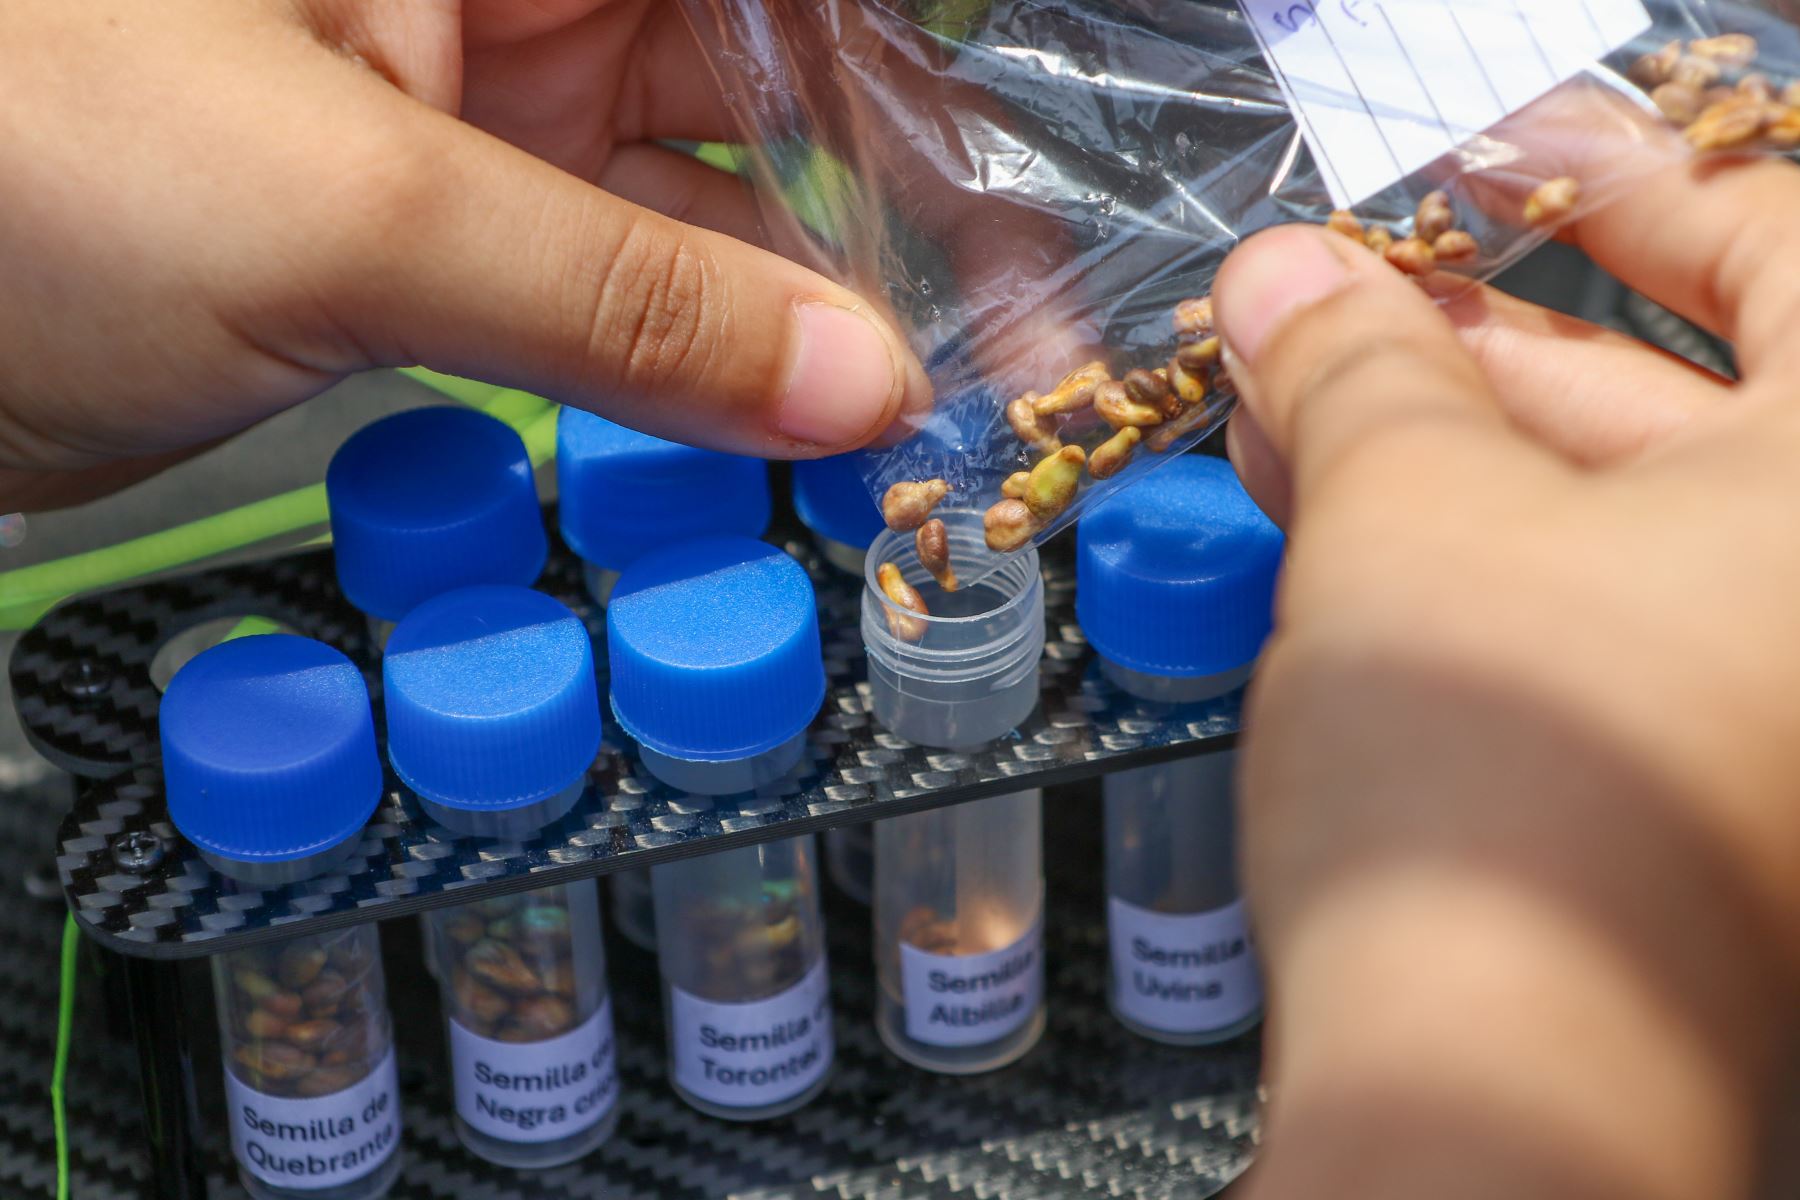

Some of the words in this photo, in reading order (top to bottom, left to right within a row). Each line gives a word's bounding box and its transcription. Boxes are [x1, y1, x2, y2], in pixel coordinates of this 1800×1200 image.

[1131, 935, 1245, 968] Semilla
[926, 950, 1035, 994] Semilla
[1132, 970, 1222, 1002] Uvina
[929, 992, 1024, 1027] Albilla
[700, 1016, 811, 1053] Semilla
[474, 1061, 587, 1093] Semilla
[242, 1104, 355, 1142] Semilla
[362, 1092, 388, 1125] de
[474, 1092, 568, 1131] Negra
